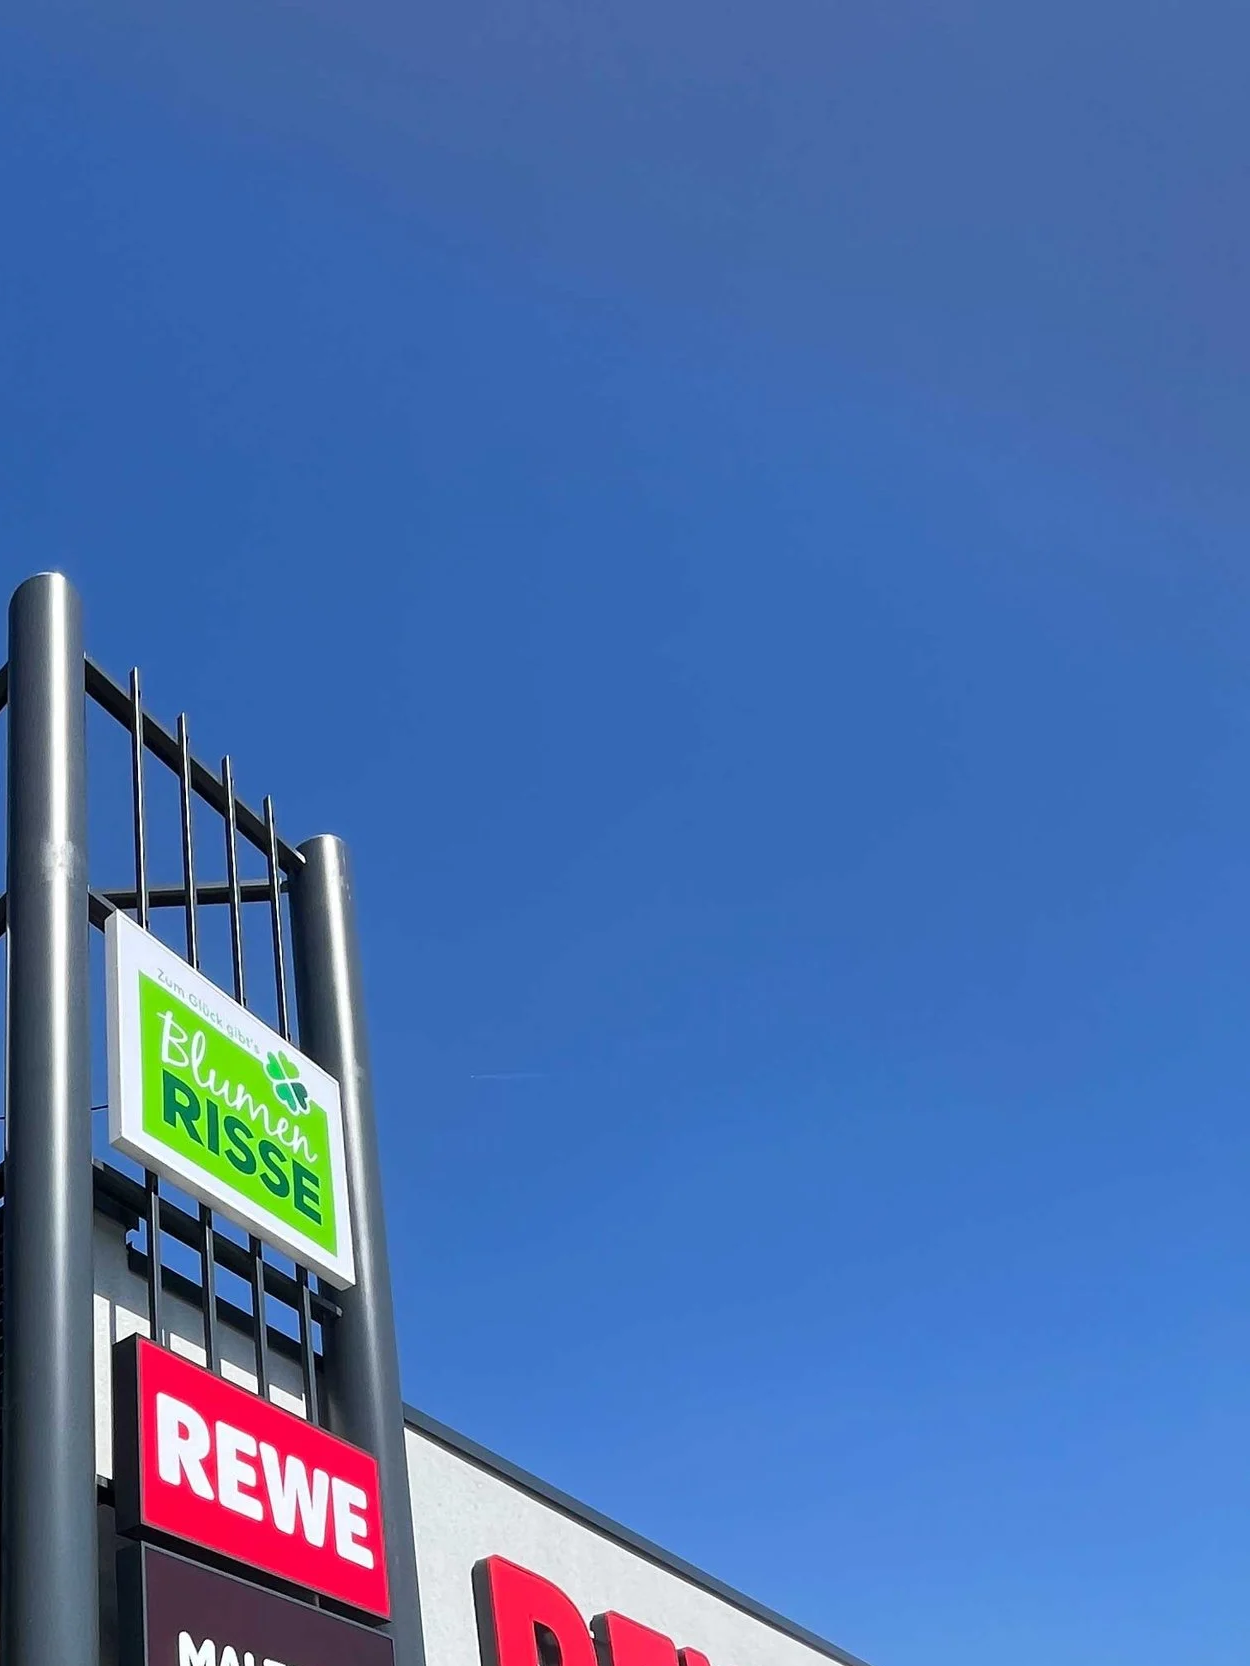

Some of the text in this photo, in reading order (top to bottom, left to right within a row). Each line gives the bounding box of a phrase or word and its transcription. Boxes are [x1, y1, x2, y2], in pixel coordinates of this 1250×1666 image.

[157, 1009, 318, 1163] Blumen
[161, 1067, 323, 1226] RISSE
[154, 1391, 376, 1571] REWE
